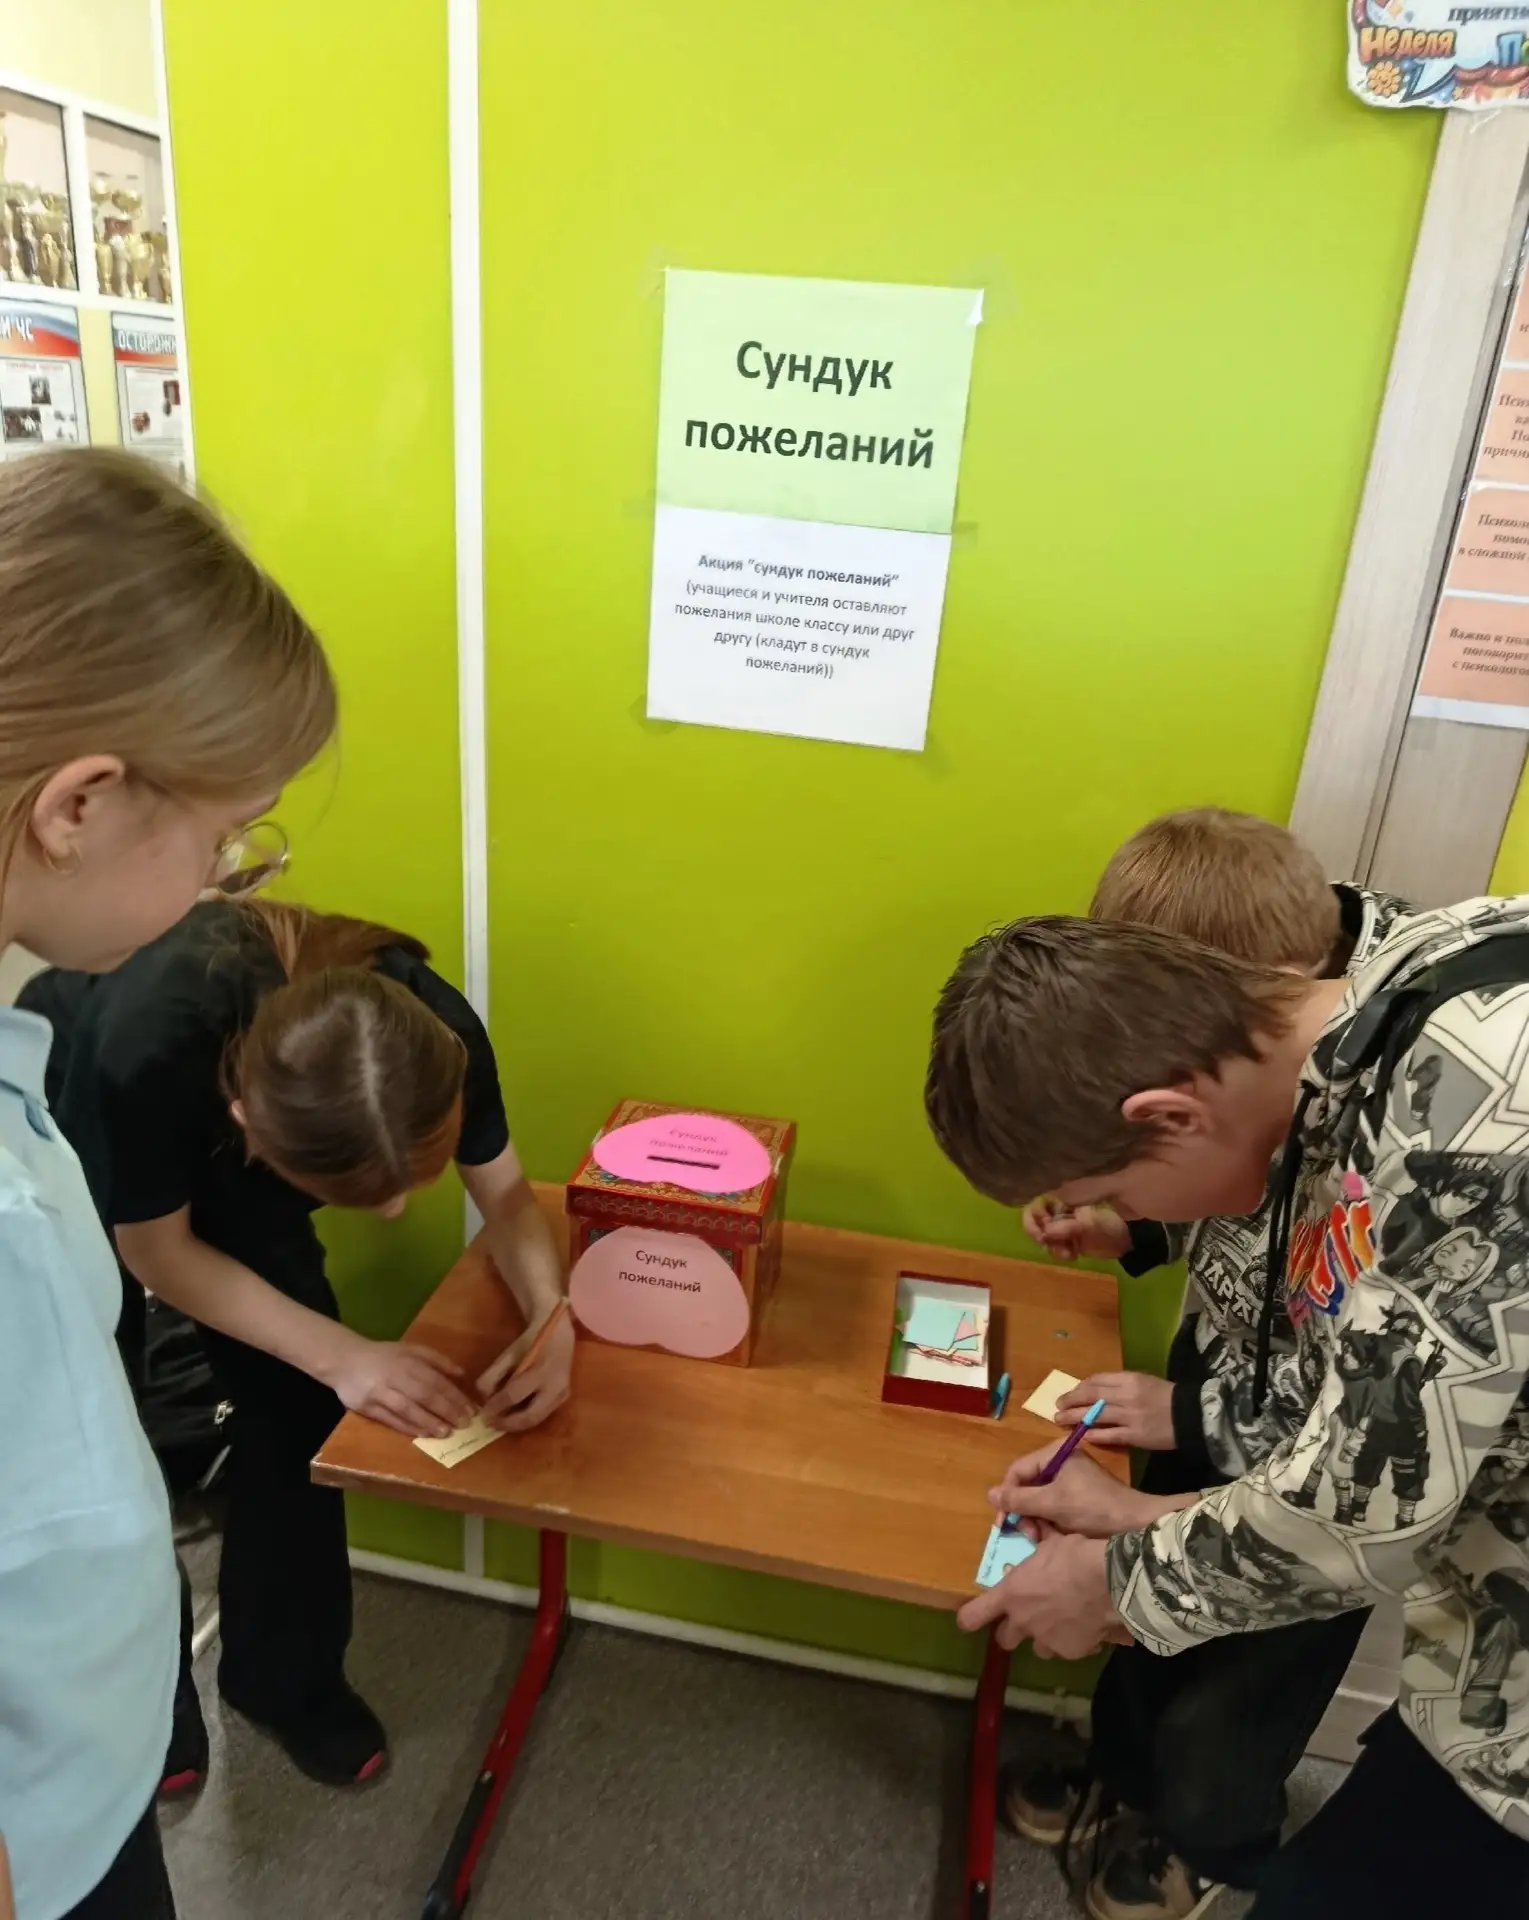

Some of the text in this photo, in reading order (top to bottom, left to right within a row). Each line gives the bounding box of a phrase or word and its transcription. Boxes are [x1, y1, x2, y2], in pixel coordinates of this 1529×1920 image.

[1360, 27, 1456, 64] Неделя
[736, 340, 894, 396] Сундук
[685, 419, 934, 468] пожеланий
[698, 555, 743, 572] Акция
[686, 580, 907, 617] (учащиеся и учителя оставляют
[675, 603, 916, 642] пожелания школе классу или друг
[714, 631, 870, 659] другу (кладут в сундук
[746, 657, 834, 680] пожеланий))
[635, 1250, 687, 1269] Сундук
[619, 1270, 701, 1293] пожеланий
